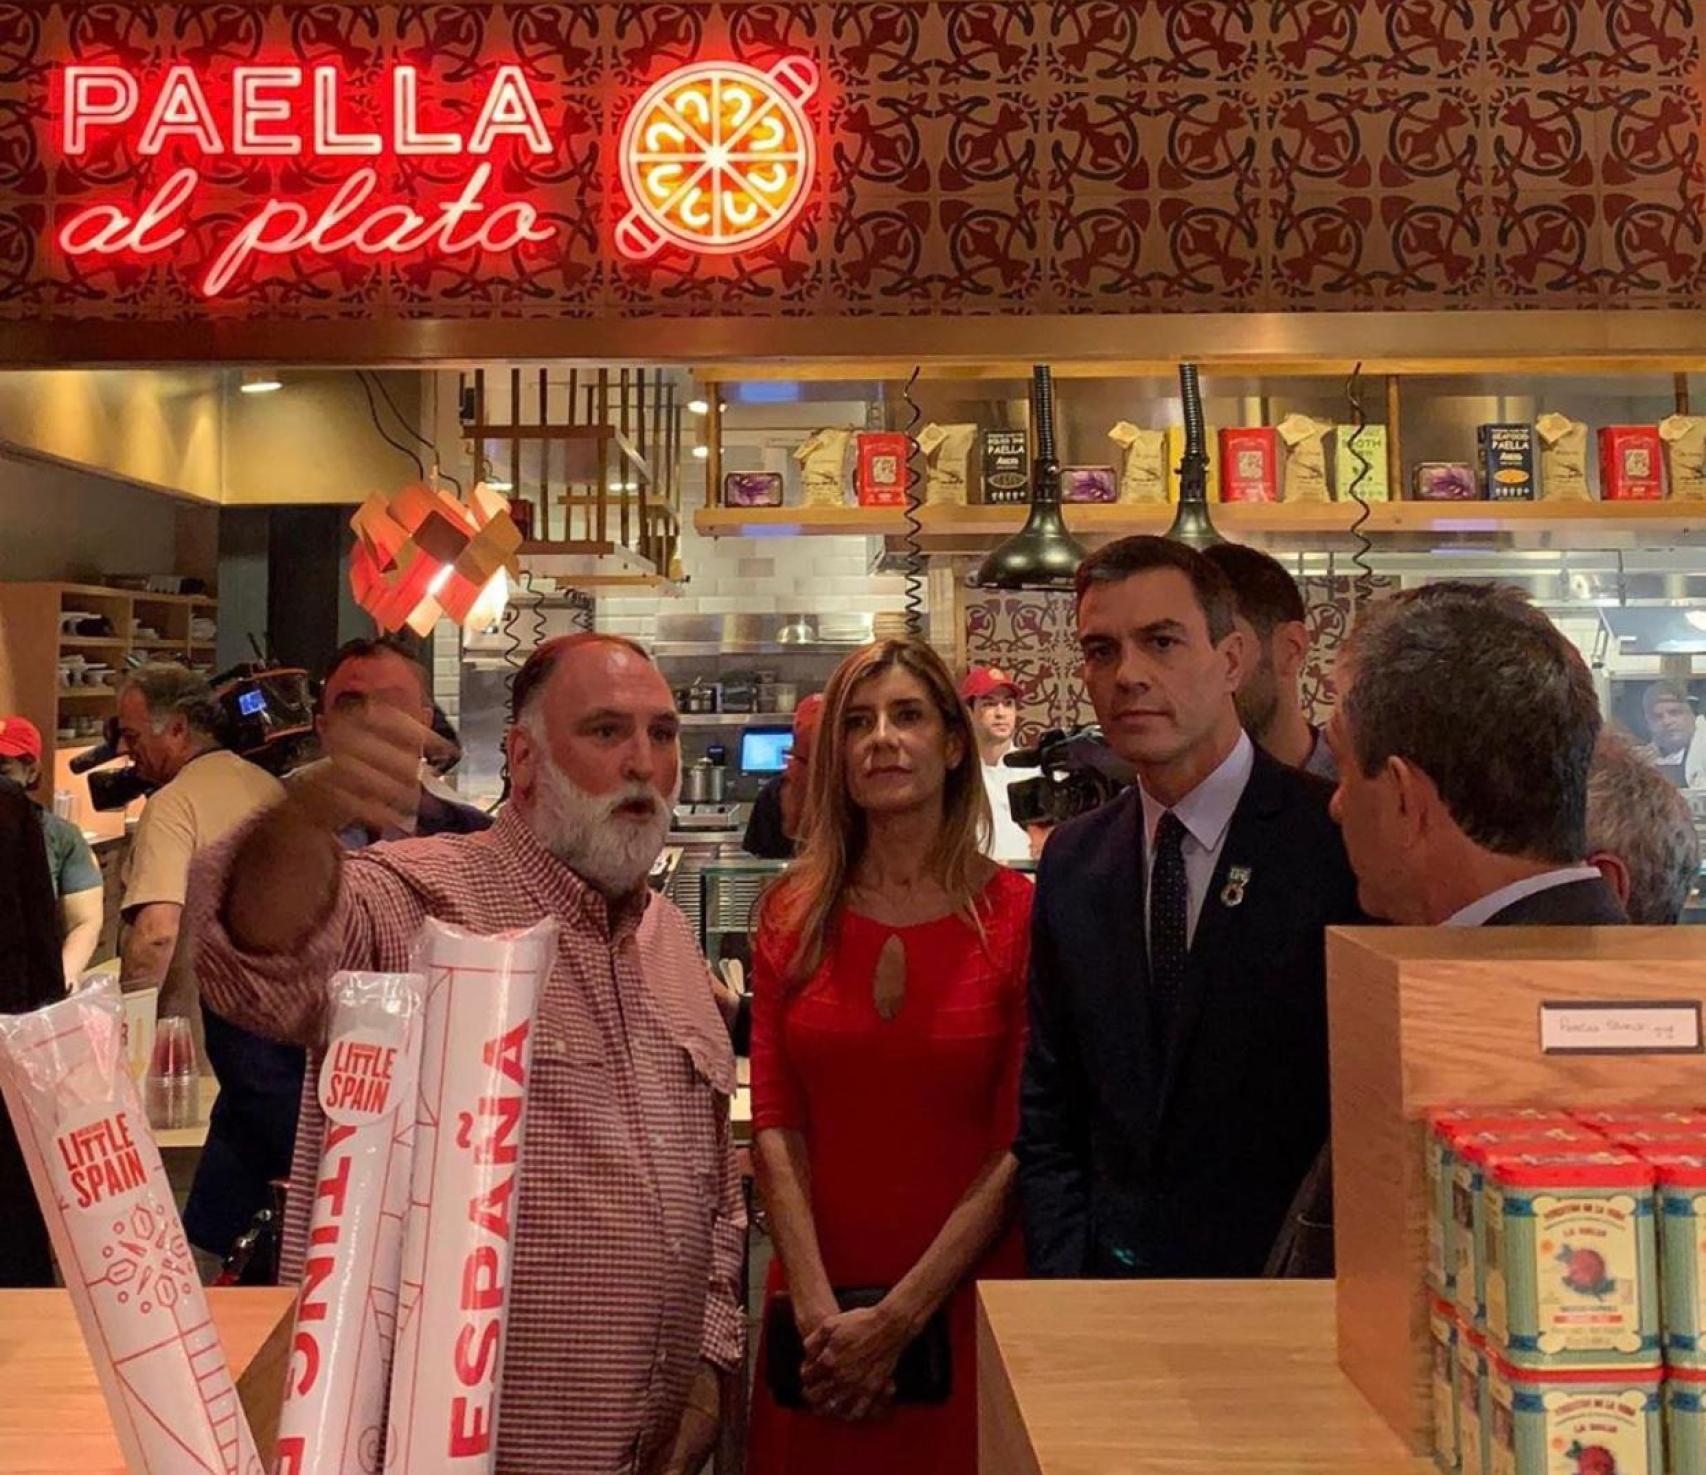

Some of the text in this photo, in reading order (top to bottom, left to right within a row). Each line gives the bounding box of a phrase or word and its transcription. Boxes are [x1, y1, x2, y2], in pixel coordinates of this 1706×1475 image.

[62, 66, 554, 155] PAELLA
[59, 161, 557, 297] al plato
[988, 445, 1025, 455] PAELLA
[1492, 440, 1529, 449] PAELLA
[334, 1041, 397, 1079] LITTLE
[326, 1074, 390, 1114] SPAIN
[58, 1112, 134, 1171] LITTLE
[71, 1148, 147, 1208] SPAIN
[448, 1017, 531, 1459] ESPAÑA
